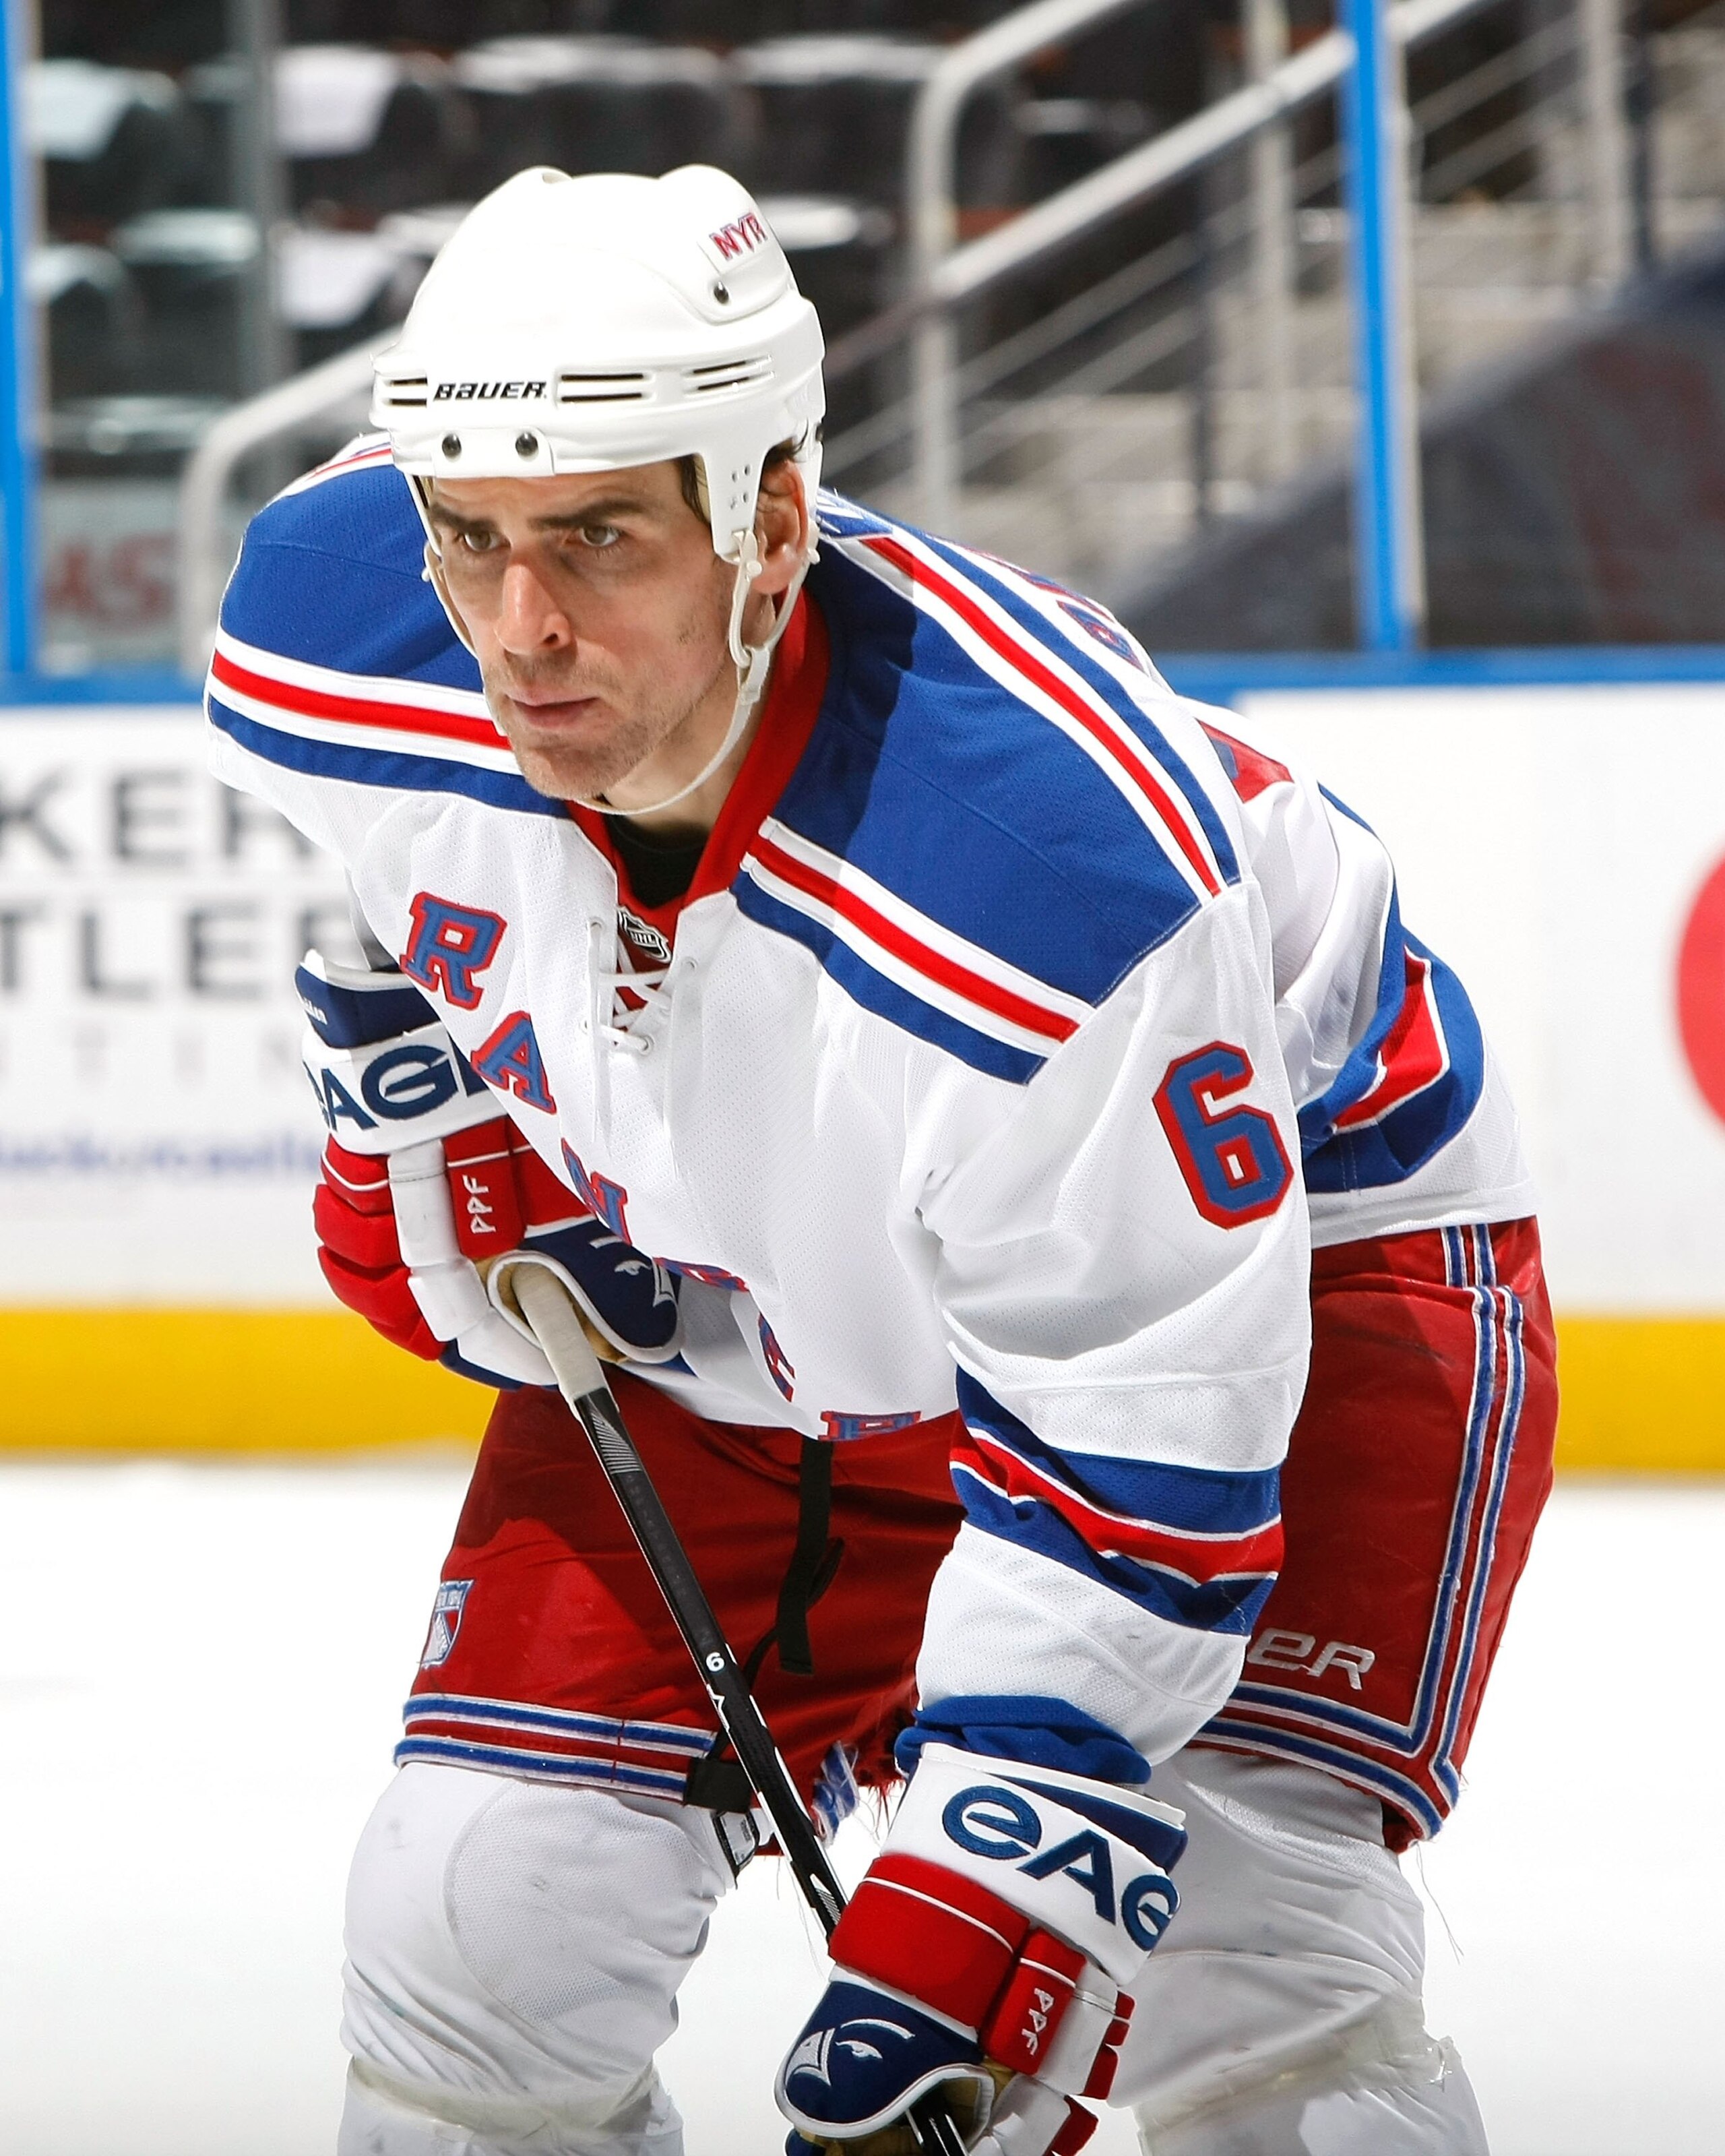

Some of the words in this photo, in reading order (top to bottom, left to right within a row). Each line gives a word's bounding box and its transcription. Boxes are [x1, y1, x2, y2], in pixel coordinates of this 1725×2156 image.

[709, 212, 767, 261] NYR
[433, 381, 546, 401] BAUER
[1152, 1041, 1294, 1231] 6
[462, 1175, 497, 1234] PPF
[705, 1652, 725, 1672] 6
[1022, 1988, 1055, 2056] PPF
